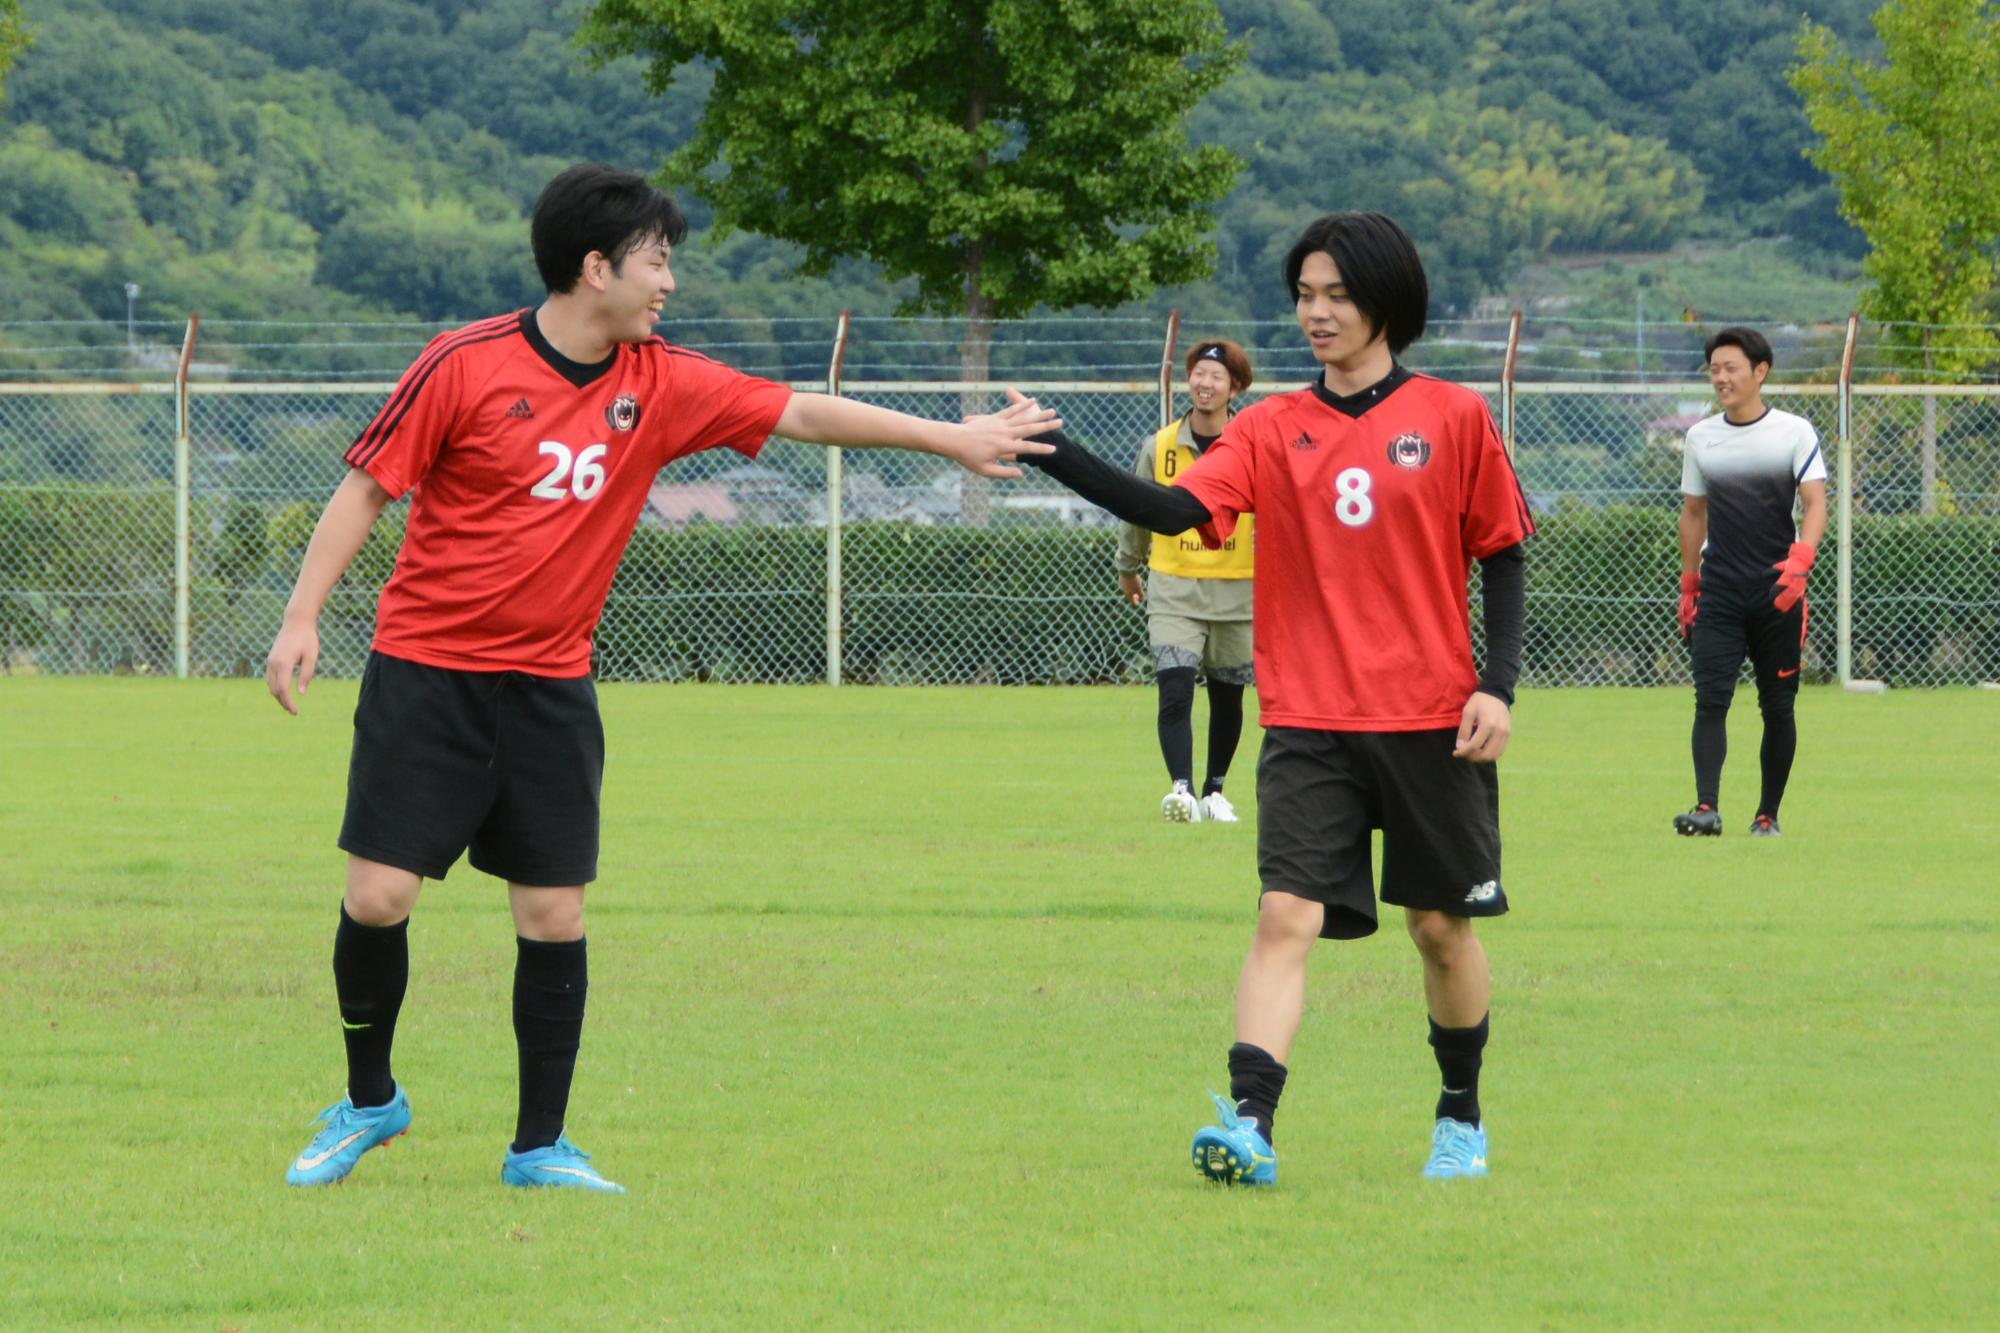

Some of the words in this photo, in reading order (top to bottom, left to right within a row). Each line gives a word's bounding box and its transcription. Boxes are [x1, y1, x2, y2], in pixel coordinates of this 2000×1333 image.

[530, 440, 608, 501] 26
[1164, 449, 1177, 478] 6
[1335, 467, 1373, 526] 8
[1180, 537, 1236, 551] huel
